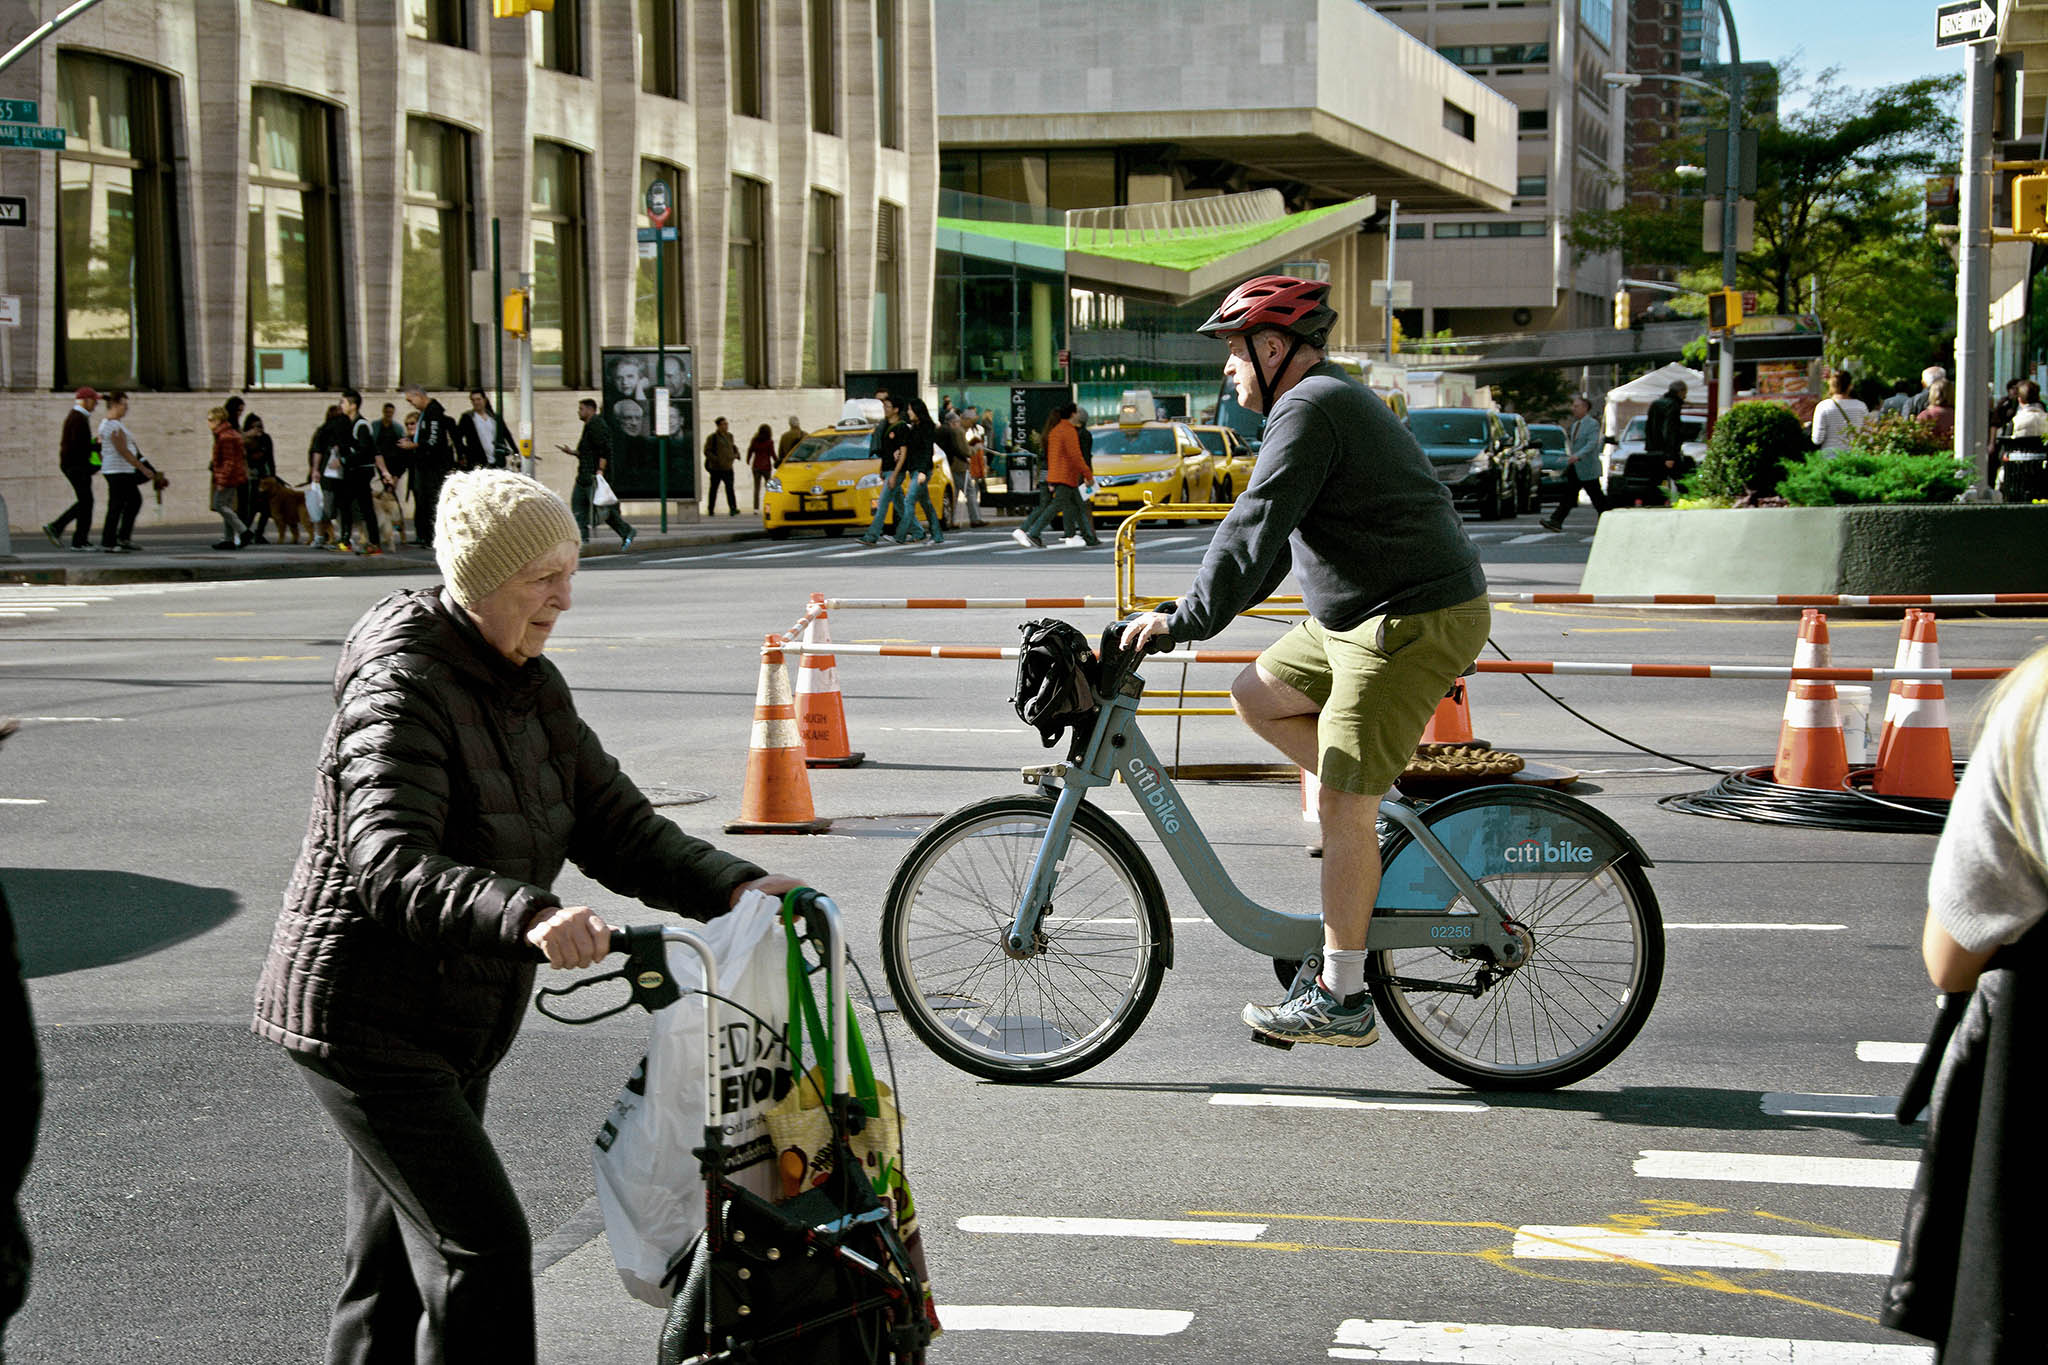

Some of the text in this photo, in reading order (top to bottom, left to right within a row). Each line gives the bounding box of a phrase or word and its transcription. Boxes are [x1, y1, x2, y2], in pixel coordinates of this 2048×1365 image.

[1944, 11, 1989, 33] ONE WAY
[1014, 405, 1026, 425] the
[1014, 427, 1026, 444] for
[1128, 758, 1180, 834] citi bike
[1503, 839, 1593, 863] citi bike
